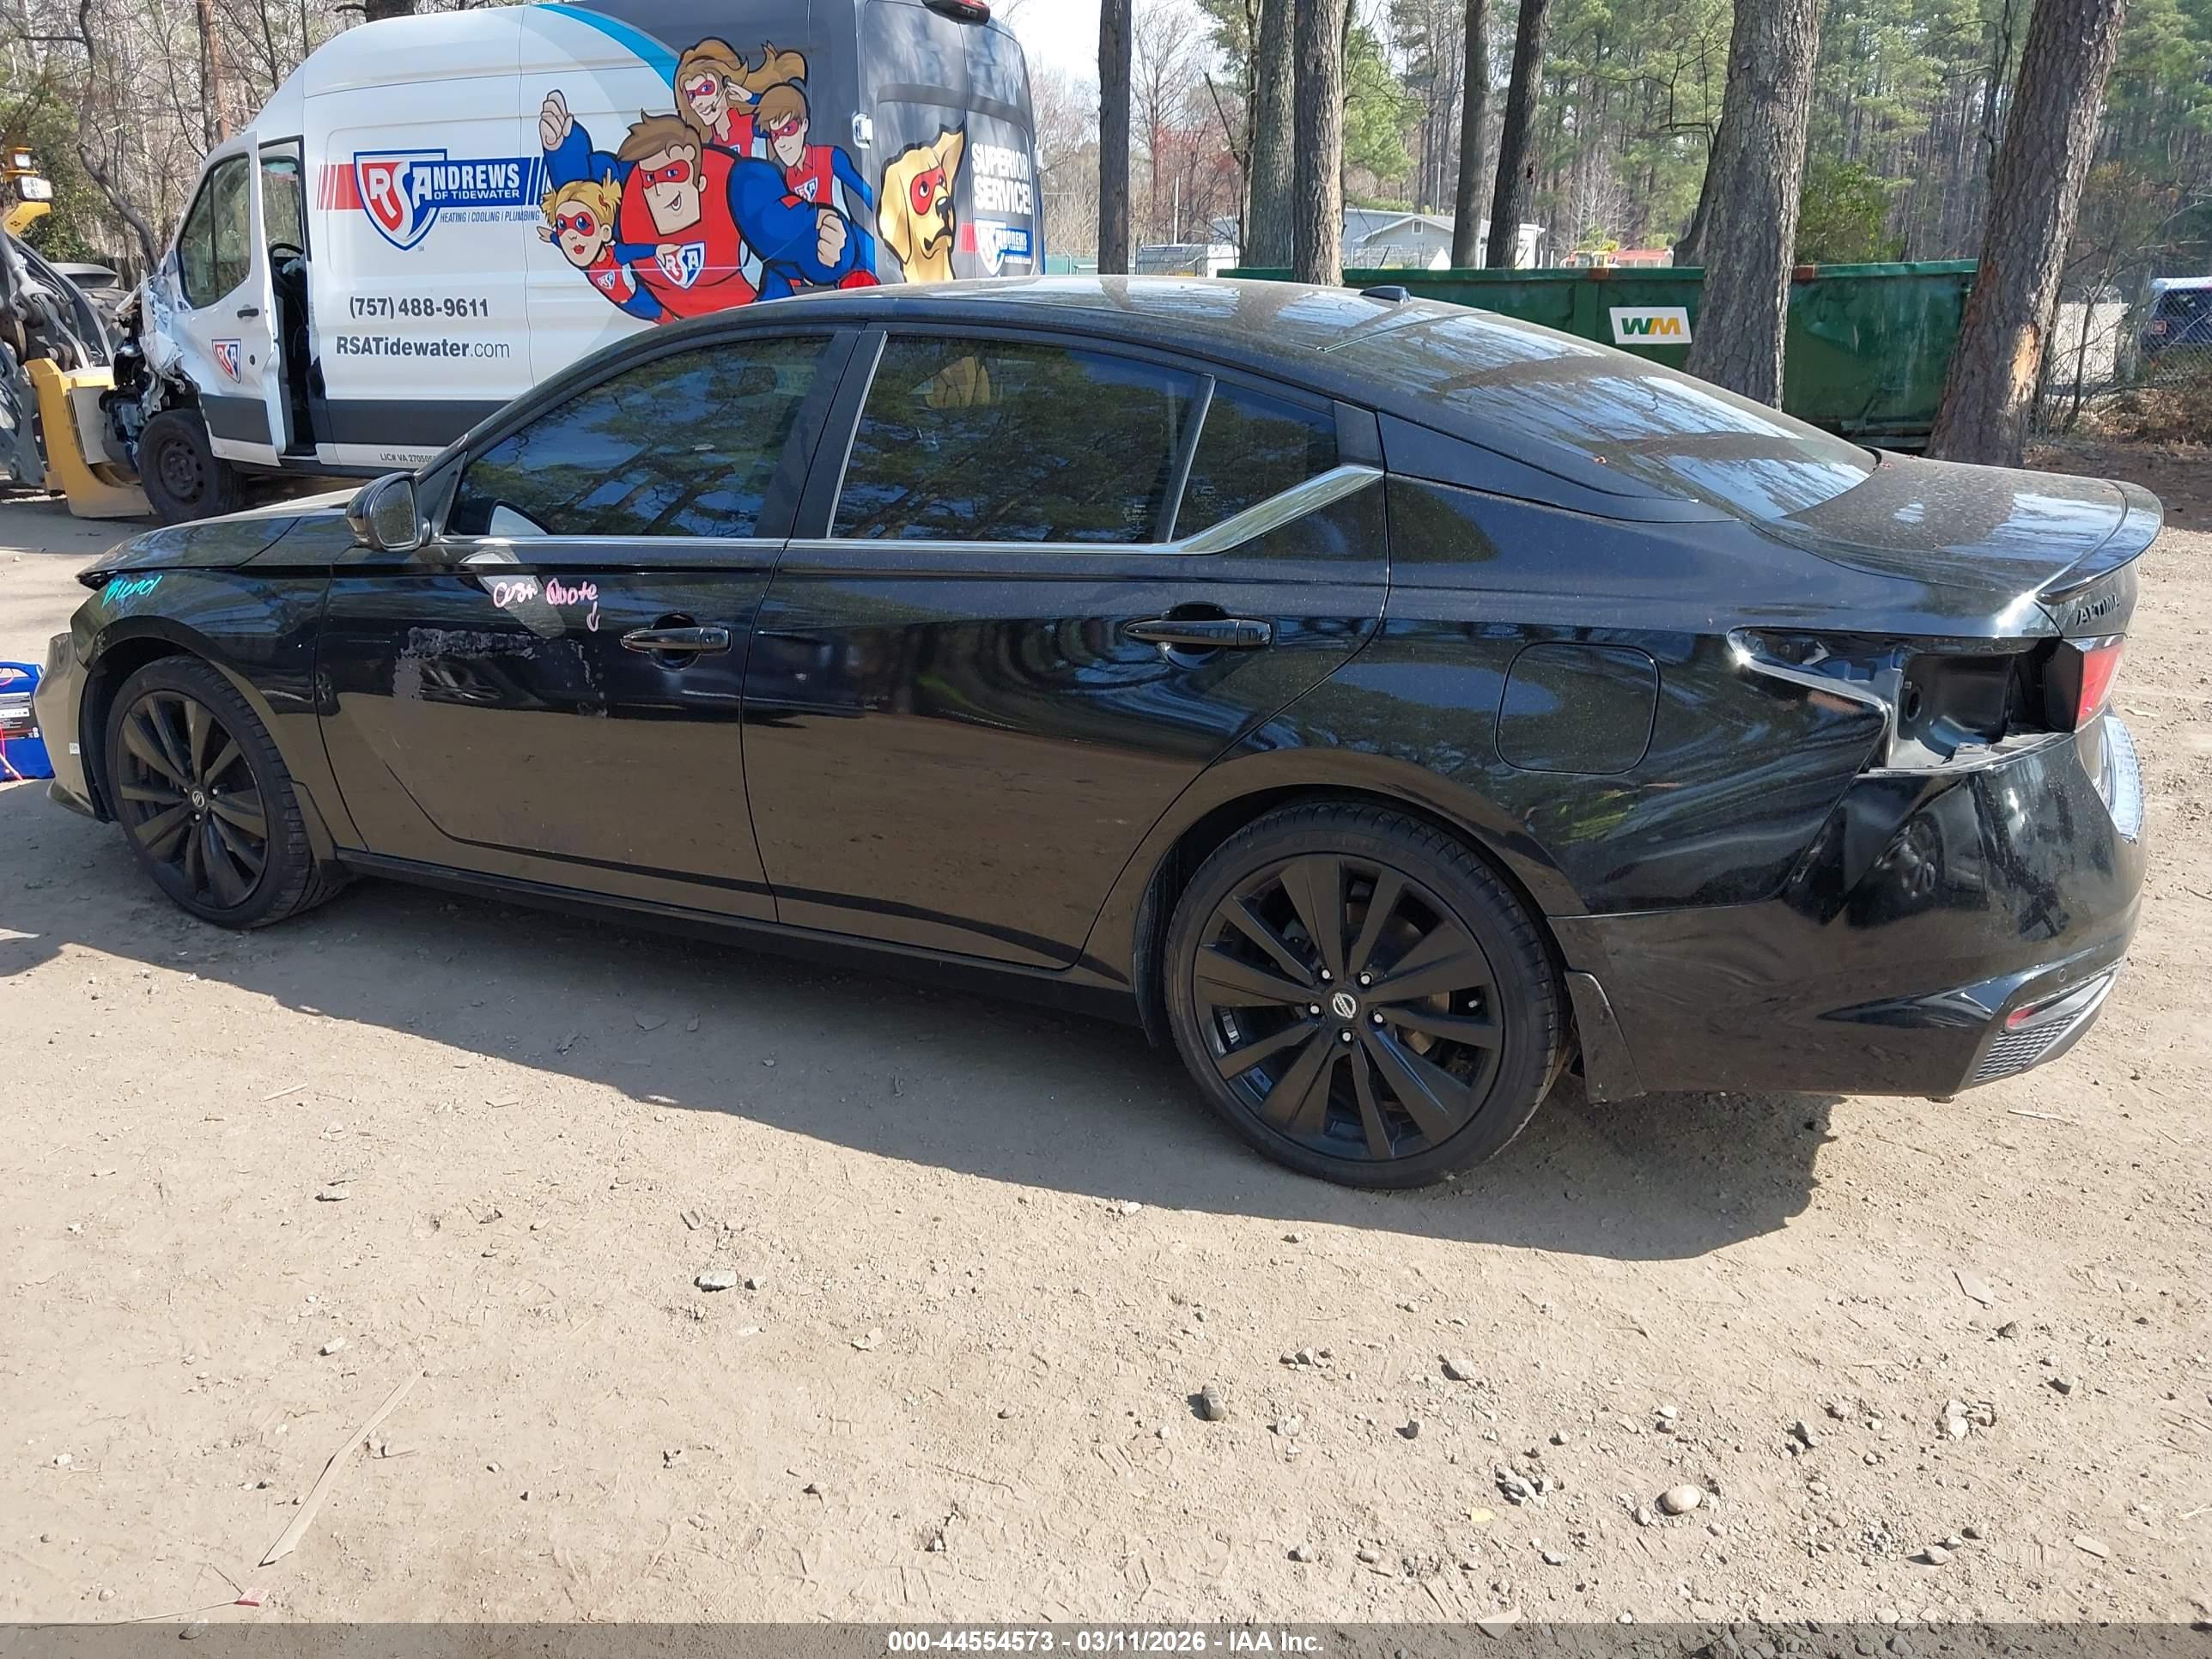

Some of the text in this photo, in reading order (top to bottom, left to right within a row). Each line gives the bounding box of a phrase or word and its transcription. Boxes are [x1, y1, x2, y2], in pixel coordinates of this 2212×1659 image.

[971, 143, 1030, 182] SUPERIOR
[434, 189, 520, 200] OF TIDEWATER
[440, 211, 466, 222] HEATING
[471, 210, 500, 222] COOLING
[505, 210, 540, 221] PLUMBING
[349, 296, 489, 319] (757) 488-9611
[1621, 317, 1681, 335] WM
[336, 336, 510, 358] RSATidewater.com
[546, 577, 599, 605] Quote
